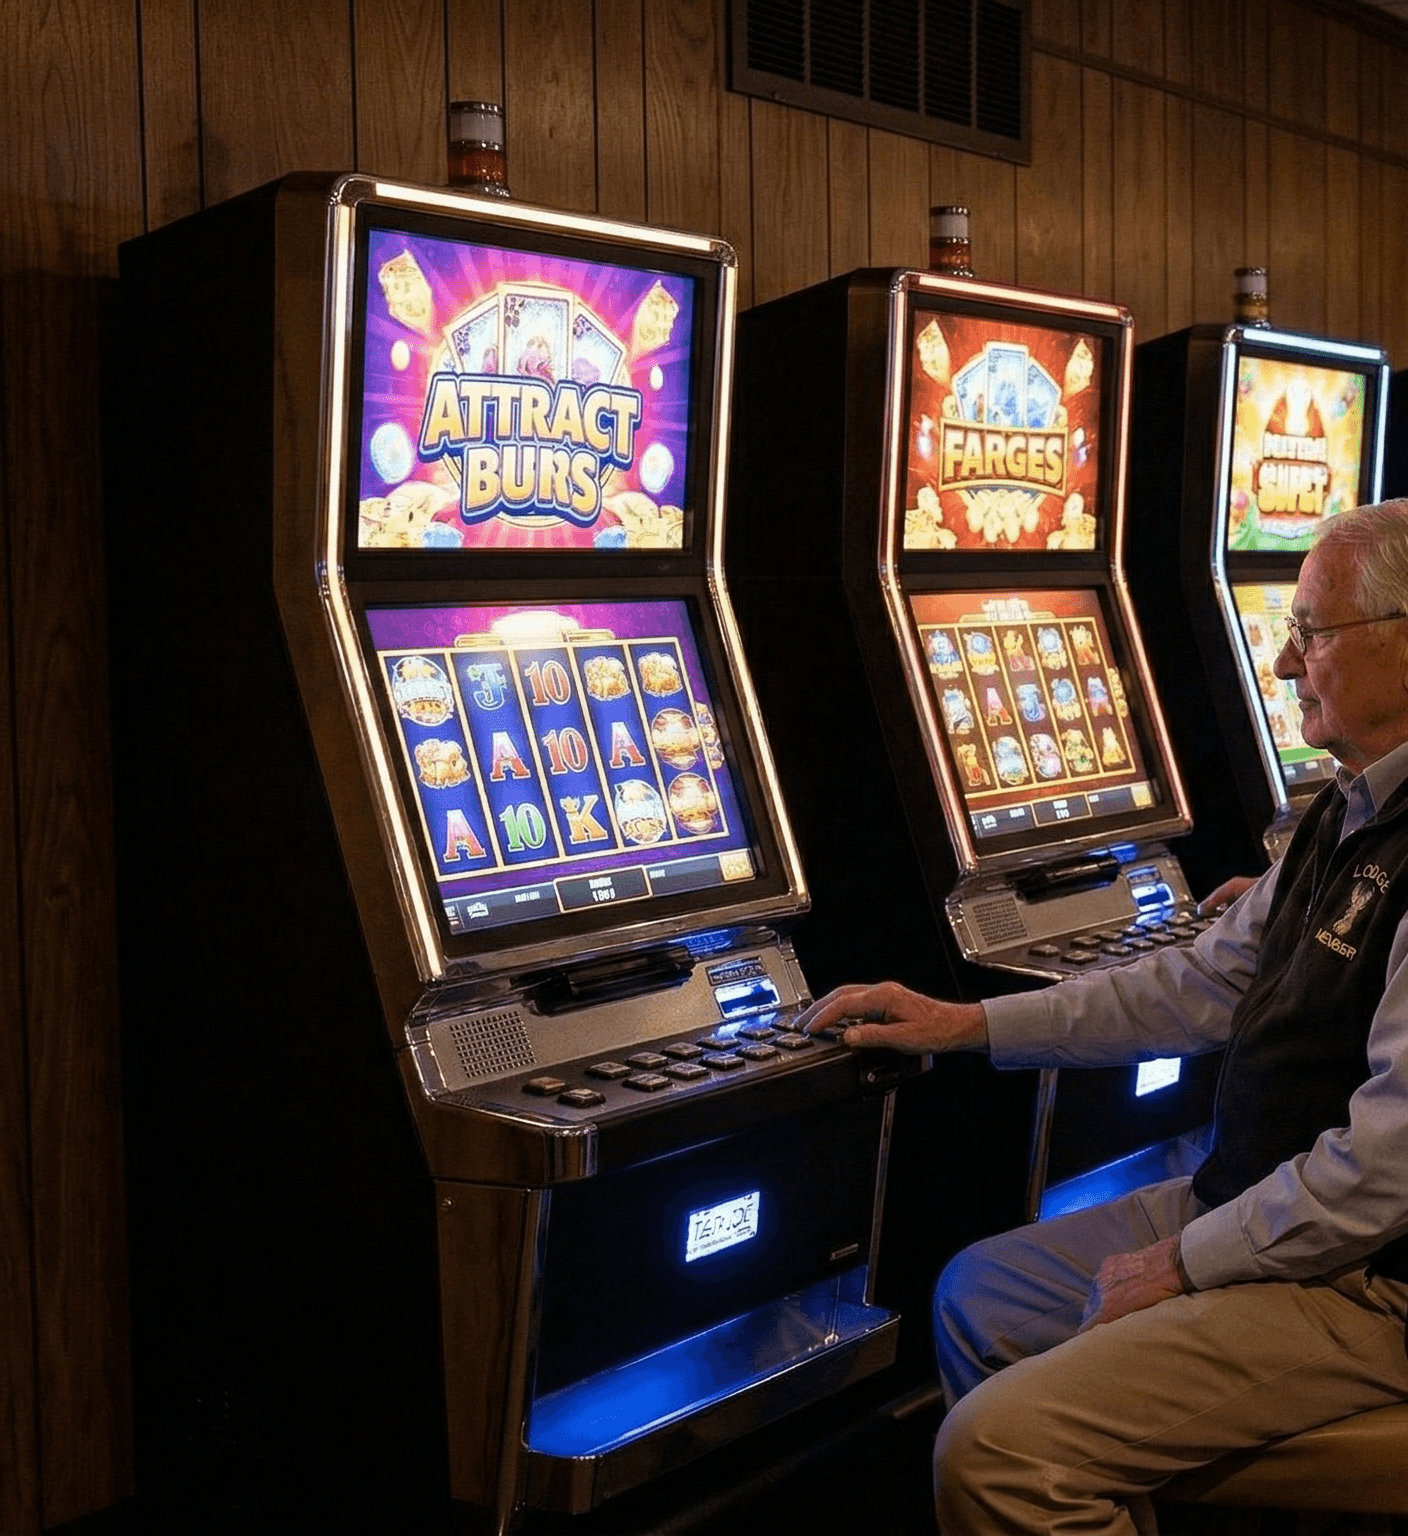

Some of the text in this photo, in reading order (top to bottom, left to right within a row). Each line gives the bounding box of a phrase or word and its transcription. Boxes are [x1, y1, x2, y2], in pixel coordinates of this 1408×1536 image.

[420, 373, 641, 467] ATTRACT
[462, 444, 600, 524] BURS
[944, 429, 1064, 484] FARGES
[524, 660, 571, 706] 10
[491, 721, 646, 781] A 10 A
[444, 809, 487, 862] A
[499, 803, 546, 852] 10
[559, 794, 608, 844] K
[1353, 864, 1389, 894] LODGE
